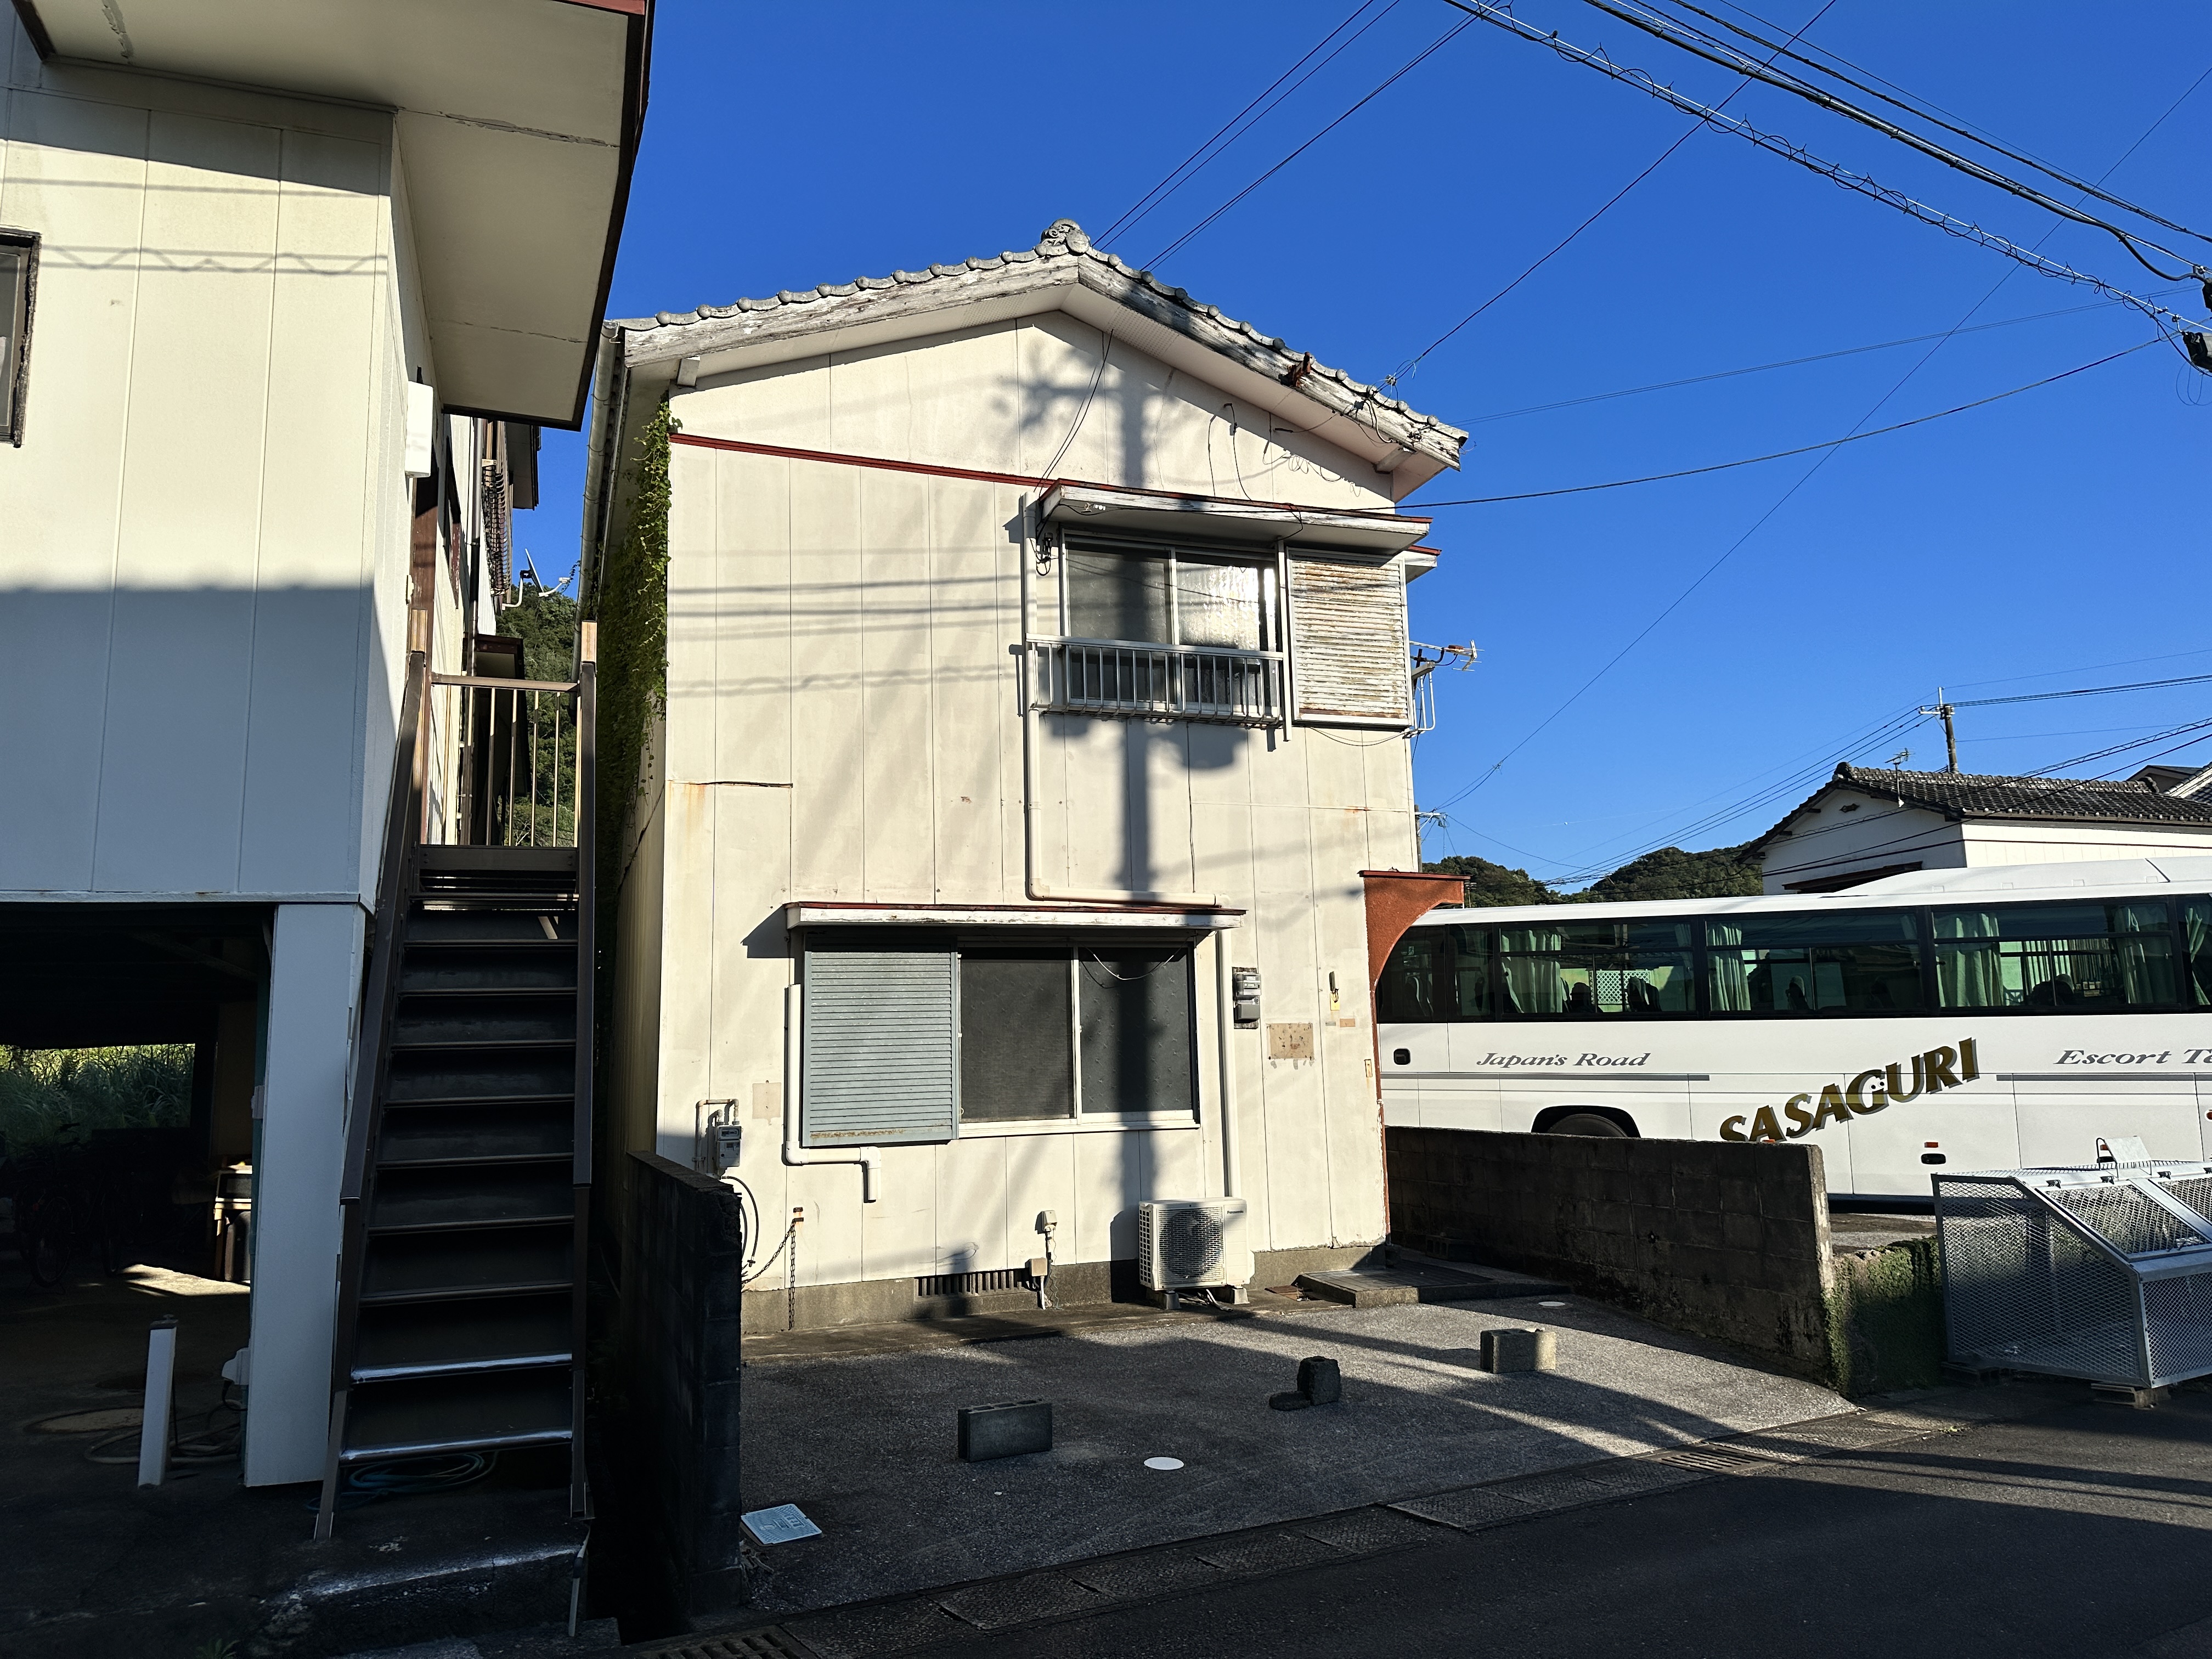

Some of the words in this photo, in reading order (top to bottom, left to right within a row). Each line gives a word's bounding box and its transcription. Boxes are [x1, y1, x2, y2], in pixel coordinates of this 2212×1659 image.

[1476, 1053, 1567, 1068] Japan's
[1573, 1053, 1651, 1066] Road
[2053, 1050, 2171, 1064] Escort
[1719, 1037, 1979, 1142] SASAGURI
